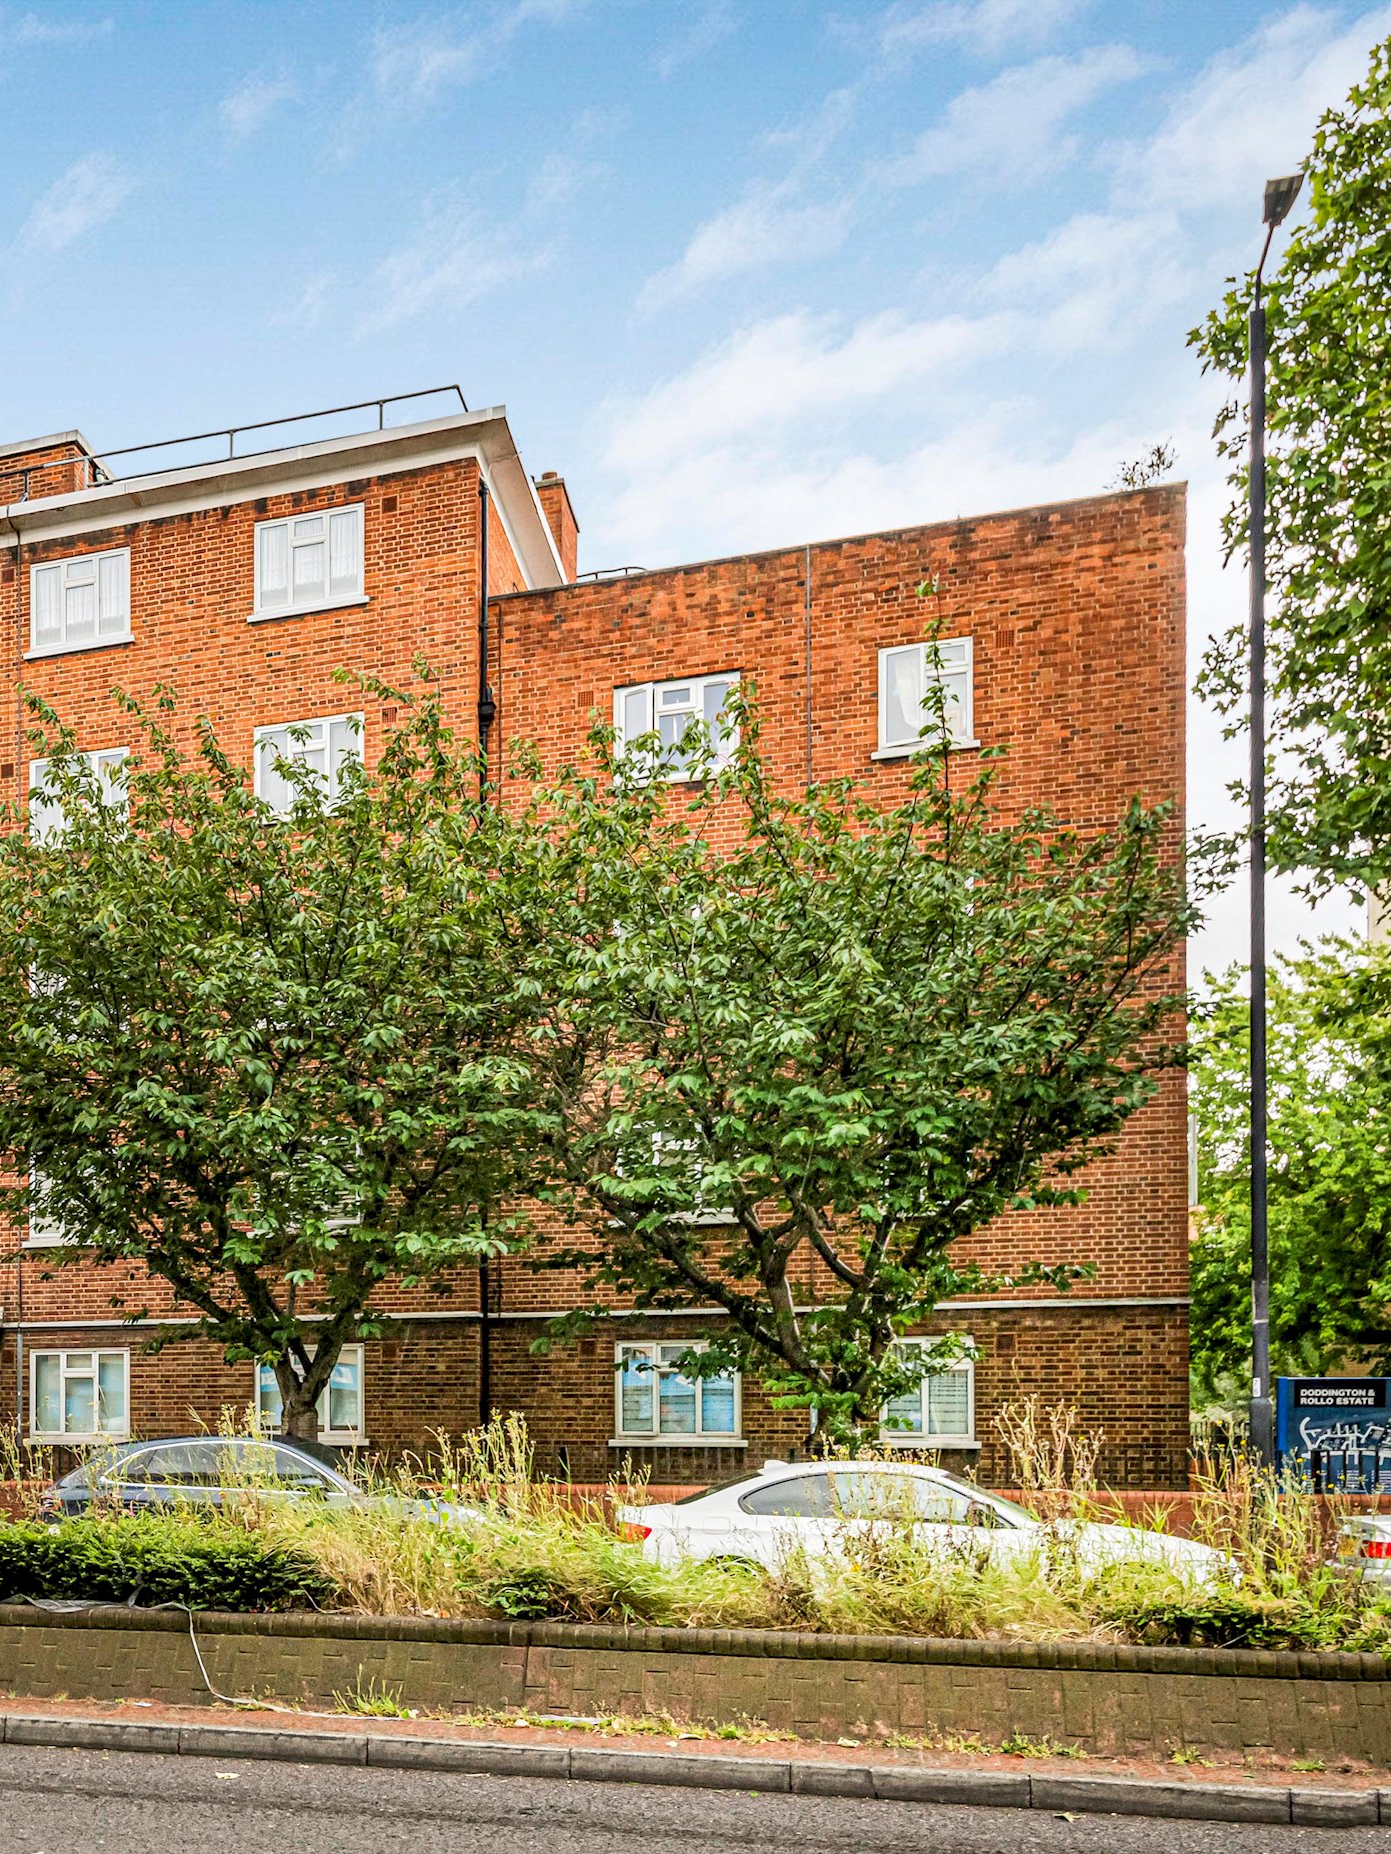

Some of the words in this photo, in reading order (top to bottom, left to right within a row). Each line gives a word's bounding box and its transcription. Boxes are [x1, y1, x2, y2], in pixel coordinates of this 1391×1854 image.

[1300, 1388, 1366, 1397] DODDINGTON
[1367, 1388, 1375, 1397] &
[1300, 1397, 1334, 1405] ROLLO
[1336, 1397, 1374, 1405] ESTATE
